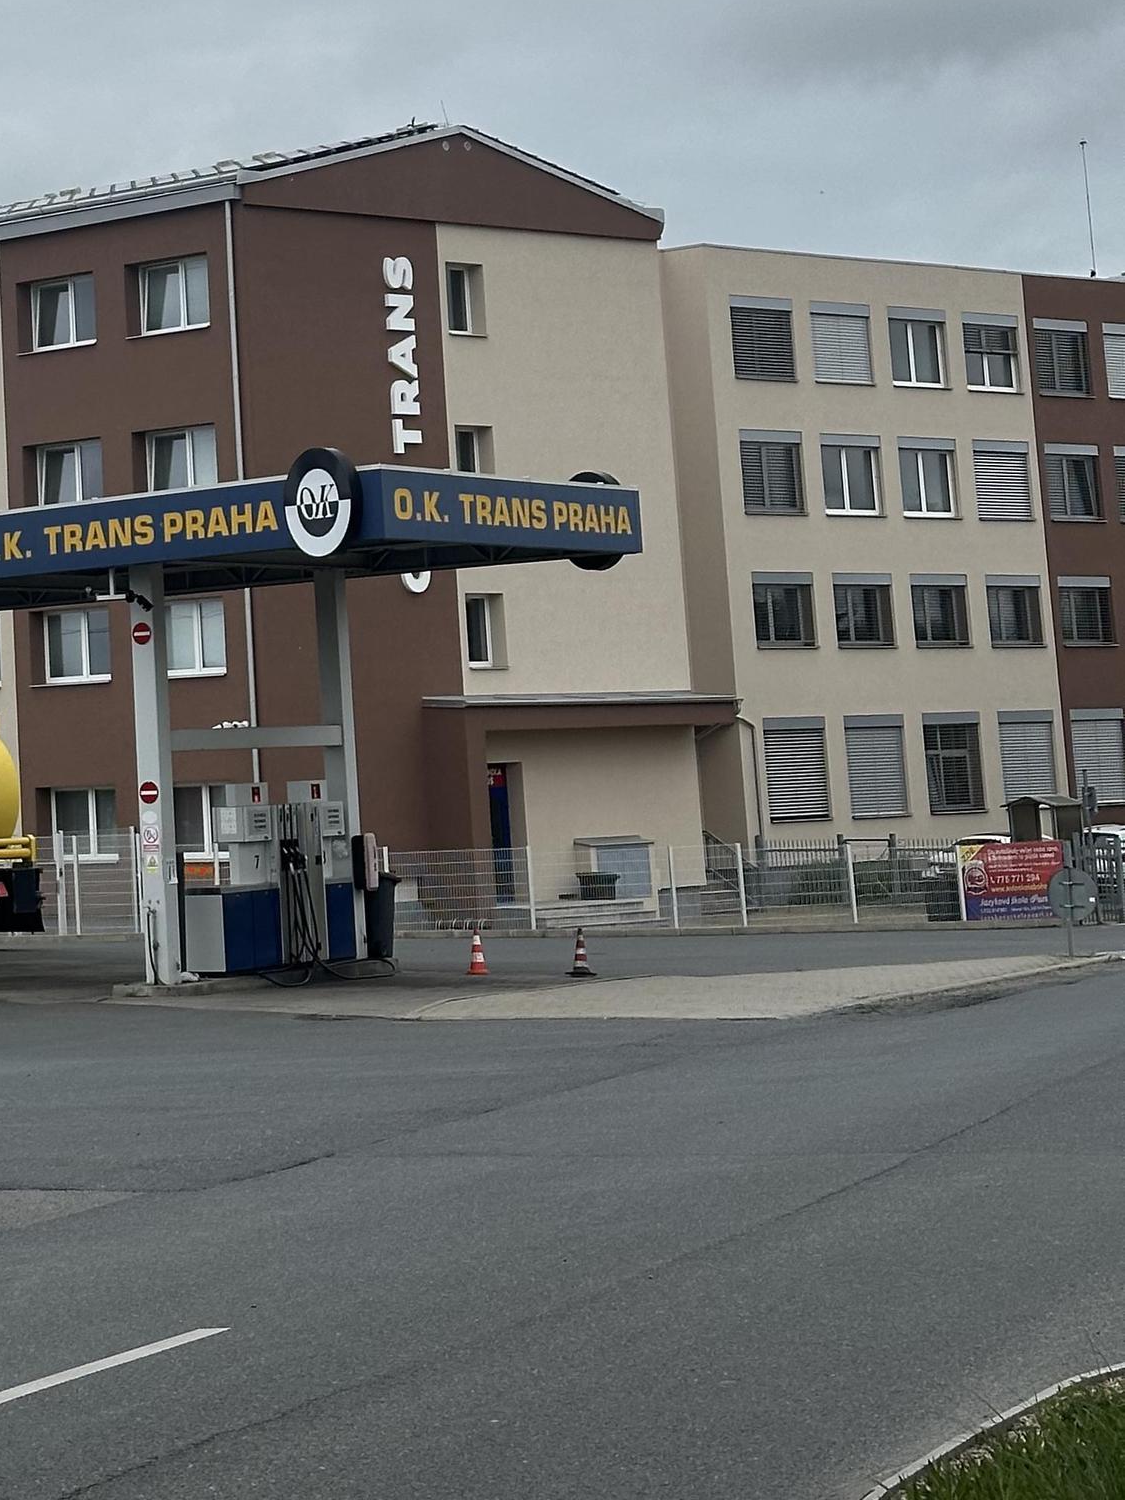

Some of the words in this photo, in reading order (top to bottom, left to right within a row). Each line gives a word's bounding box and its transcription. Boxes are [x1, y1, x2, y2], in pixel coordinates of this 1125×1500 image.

[383, 256, 423, 454] TRANS
[43, 514, 155, 556] TRANS
[162, 499, 279, 543] PRAHA
[393, 487, 450, 524] O.K.
[458, 492, 547, 530] TRANS
[553, 500, 633, 535] PRAHA
[254, 854, 261, 869] 7
